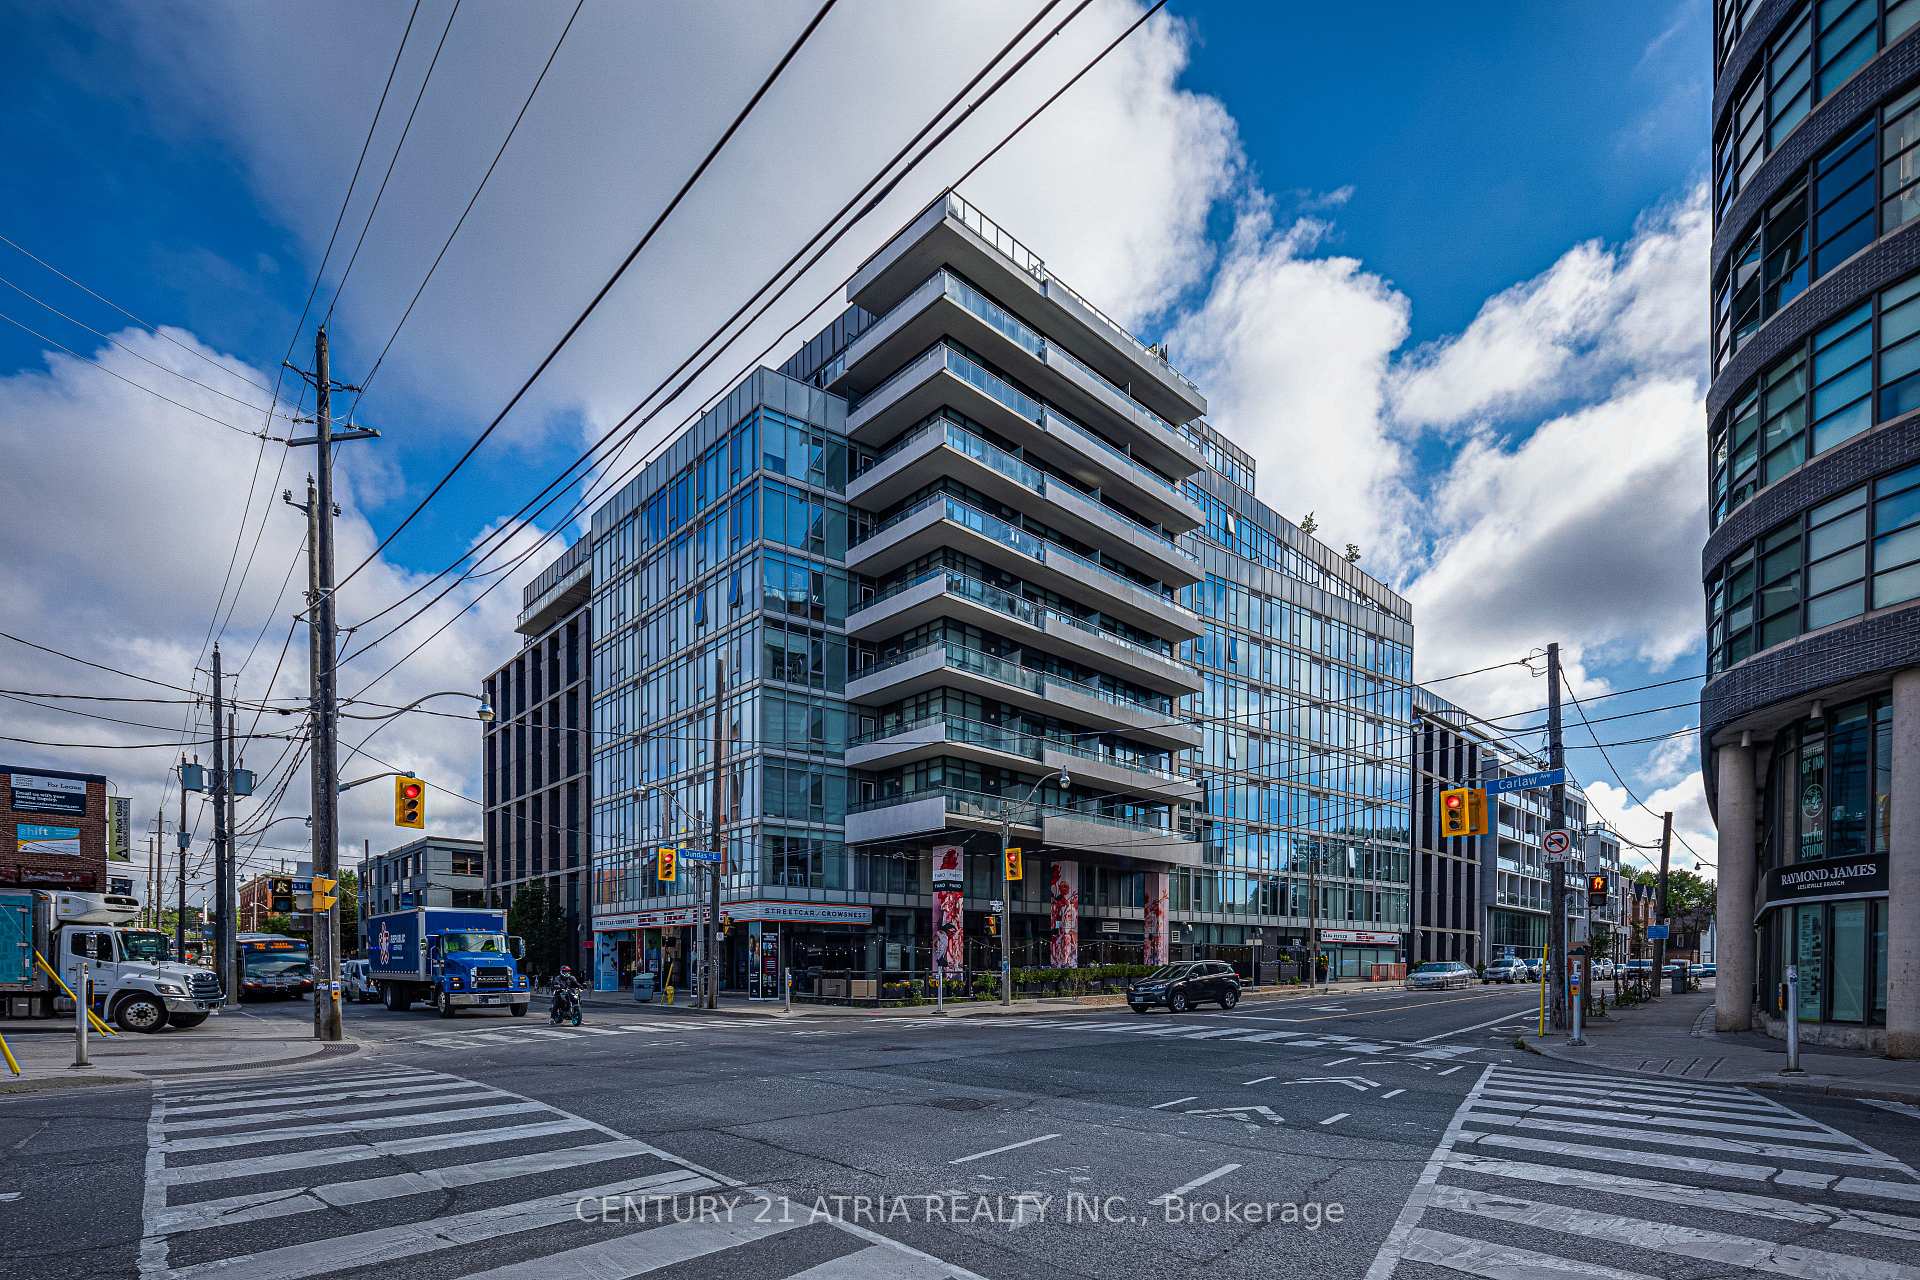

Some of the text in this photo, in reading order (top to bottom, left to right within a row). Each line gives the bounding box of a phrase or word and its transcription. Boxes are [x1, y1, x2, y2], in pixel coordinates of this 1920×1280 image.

[1498, 776, 1537, 790] Carlaw
[114, 800, 123, 847] The Rock Oasis
[685, 851, 708, 859] Dundas
[1781, 863, 1877, 886] RAYMOND JAMES
